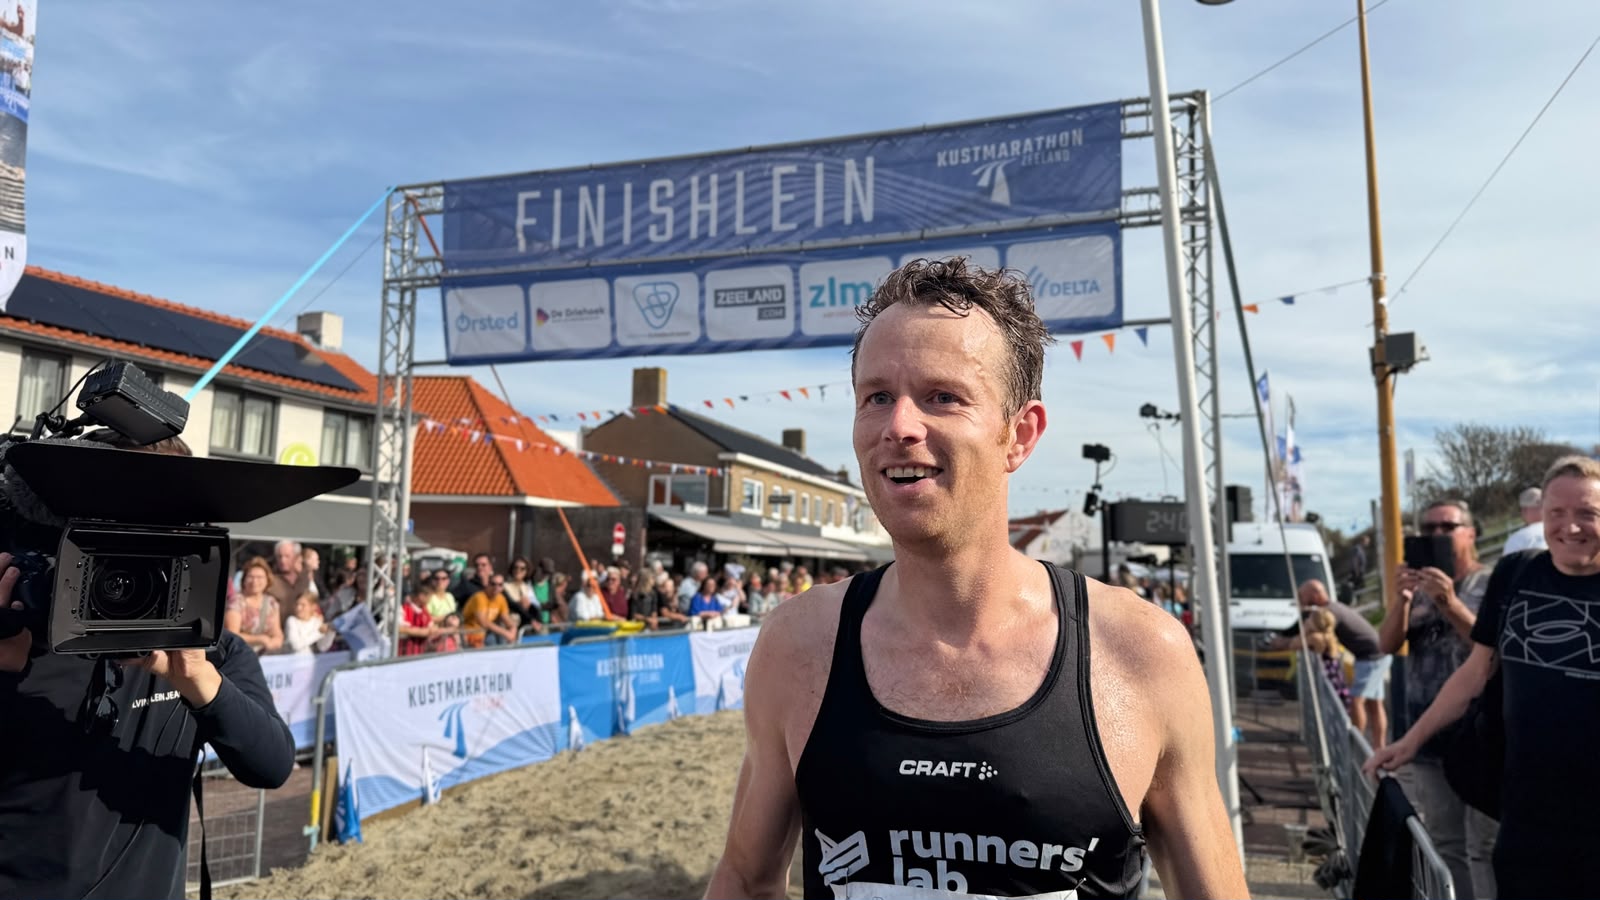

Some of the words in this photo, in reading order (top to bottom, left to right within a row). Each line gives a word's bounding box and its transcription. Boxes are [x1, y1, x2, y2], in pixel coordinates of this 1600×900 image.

[937, 128, 1083, 167] KUSTMARATHON
[515, 156, 875, 253] FINISHLEIN
[717, 288, 783, 305] ZEELAND
[808, 276, 873, 308] zlm
[1049, 279, 1100, 297] DELTA
[408, 671, 513, 709] KUSTMARATHON
[899, 759, 977, 778] CRAFT
[893, 857, 969, 895] lab
